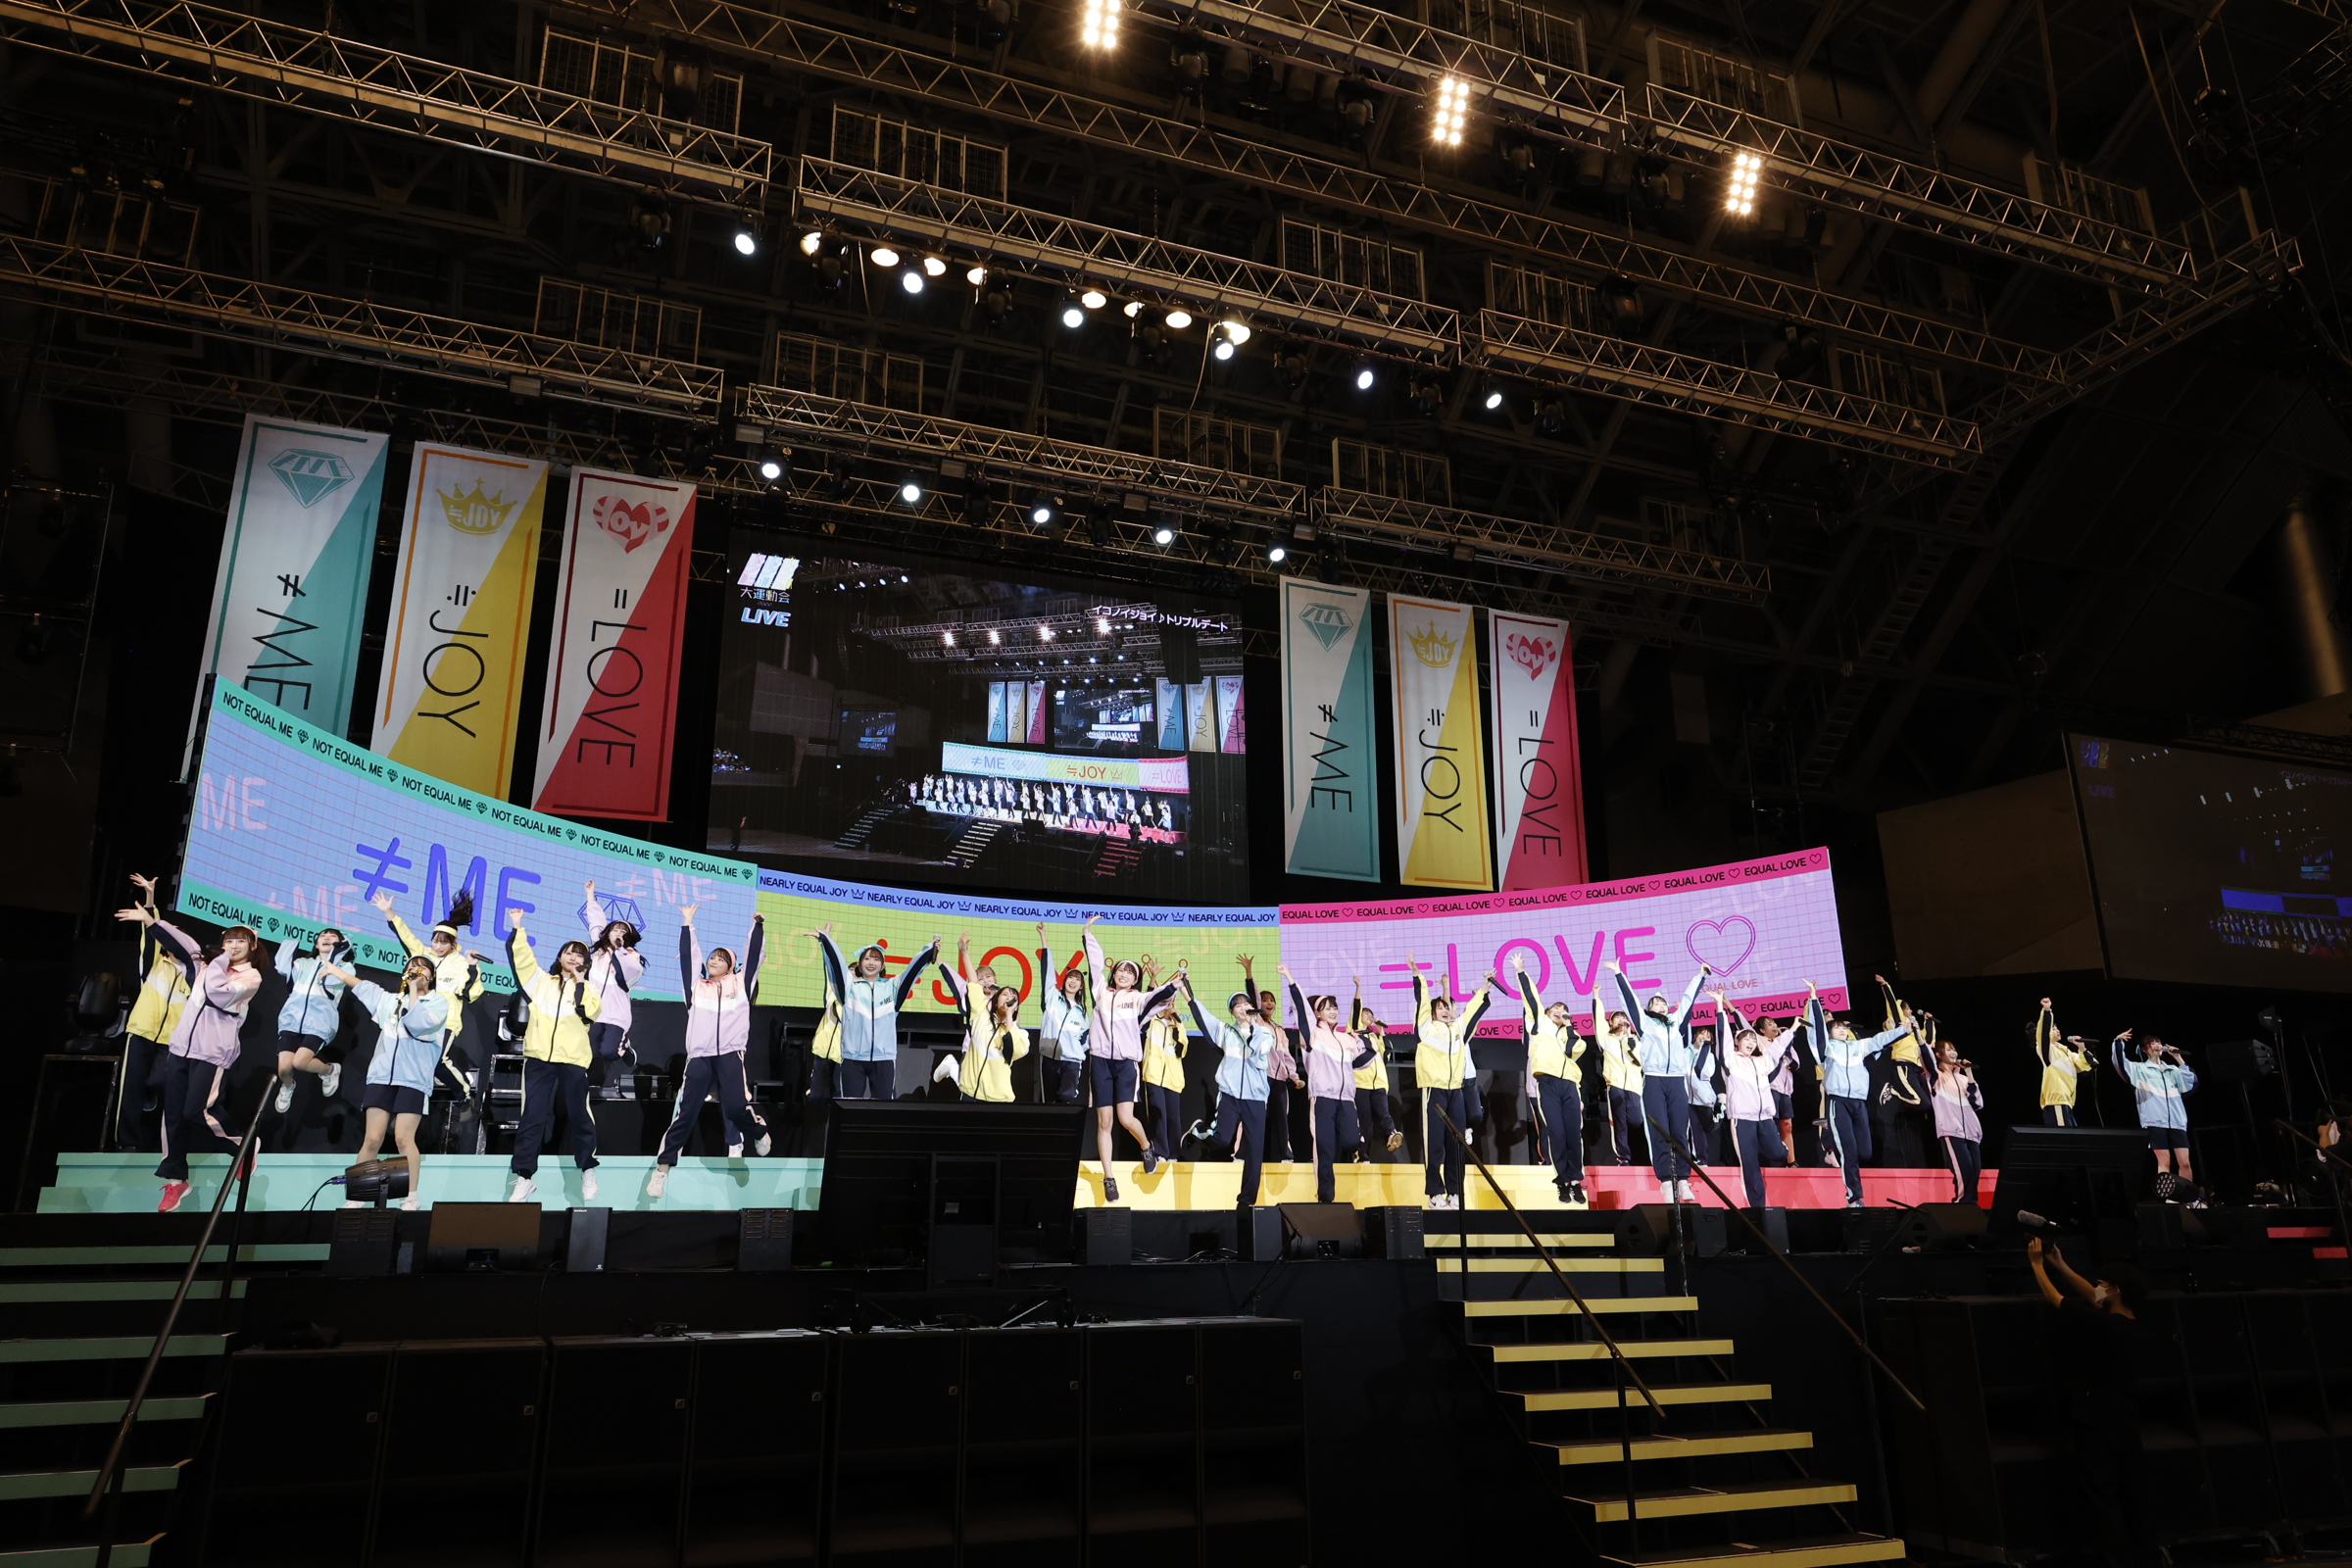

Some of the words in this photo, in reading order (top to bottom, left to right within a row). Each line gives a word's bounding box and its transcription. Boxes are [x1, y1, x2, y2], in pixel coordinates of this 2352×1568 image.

[741, 607, 792, 627] LIVE
[222, 691, 244, 711] NOT
[245, 705, 277, 730] EQUAL
[278, 719, 293, 739] ME
[313, 738, 333, 756] NOT
[334, 748, 367, 771] EQUAL
[368, 762, 383, 777] ME
[402, 776, 422, 792] NOT
[424, 785, 456, 806] EQUAL
[458, 797, 472, 810] ME
[492, 808, 512, 822] NOT
[514, 814, 545, 833] EQUAL
[548, 825, 562, 838] ME
[581, 834, 602, 848] NOT
[603, 841, 634, 856] EQUAL
[636, 849, 650, 859] ME
[669, 856, 689, 867] NOT
[691, 860, 721, 875] EQUAL
[724, 867, 738, 878] ME
[760, 876, 797, 890] NEARLY
[797, 882, 827, 895] EQUAL
[829, 887, 849, 898] JOY
[867, 892, 904, 905] NEARLY
[905, 897, 935, 908] EQUAL
[937, 900, 956, 909] JOY
[974, 904, 1010, 915] NEARLY
[1011, 906, 1042, 917] EQUAL
[1044, 908, 1062, 918] JOY
[1118, 911, 1149, 921] EQUAL
[1151, 912, 1169, 922] JOY
[1188, 913, 1223, 922] NEARLY
[1225, 913, 1255, 923] EQUAL
[1257, 913, 1276, 923] JOY
[1282, 909, 1313, 919] EQUAL
[1315, 909, 1340, 918] LOVE
[1356, 907, 1389, 917] EQUAL
[1391, 906, 1415, 915] LOVE
[1432, 903, 1464, 912] EQUAL
[1466, 900, 1491, 910] LOVE
[1508, 896, 1541, 906] EQUAL
[1543, 893, 1568, 904] LOVE
[1586, 887, 1619, 899] EQUAL
[1620, 883, 1646, 895] LOVE
[1664, 877, 1697, 889] EQUAL
[1699, 871, 1726, 884] LOVE
[1743, 863, 1779, 877] EQUAL
[1780, 857, 1807, 871] LOVE
[188, 892, 211, 911] NOT
[212, 901, 245, 923] EQUAL
[247, 912, 264, 929] ME
[283, 923, 306, 940] NOT
[378, 949, 400, 964] NOT
[479, 971, 494, 984] OT
[495, 974, 517, 989] EQU
[1732, 979, 1759, 990] LOVE
[1761, 1001, 1795, 1012] EQUAL
